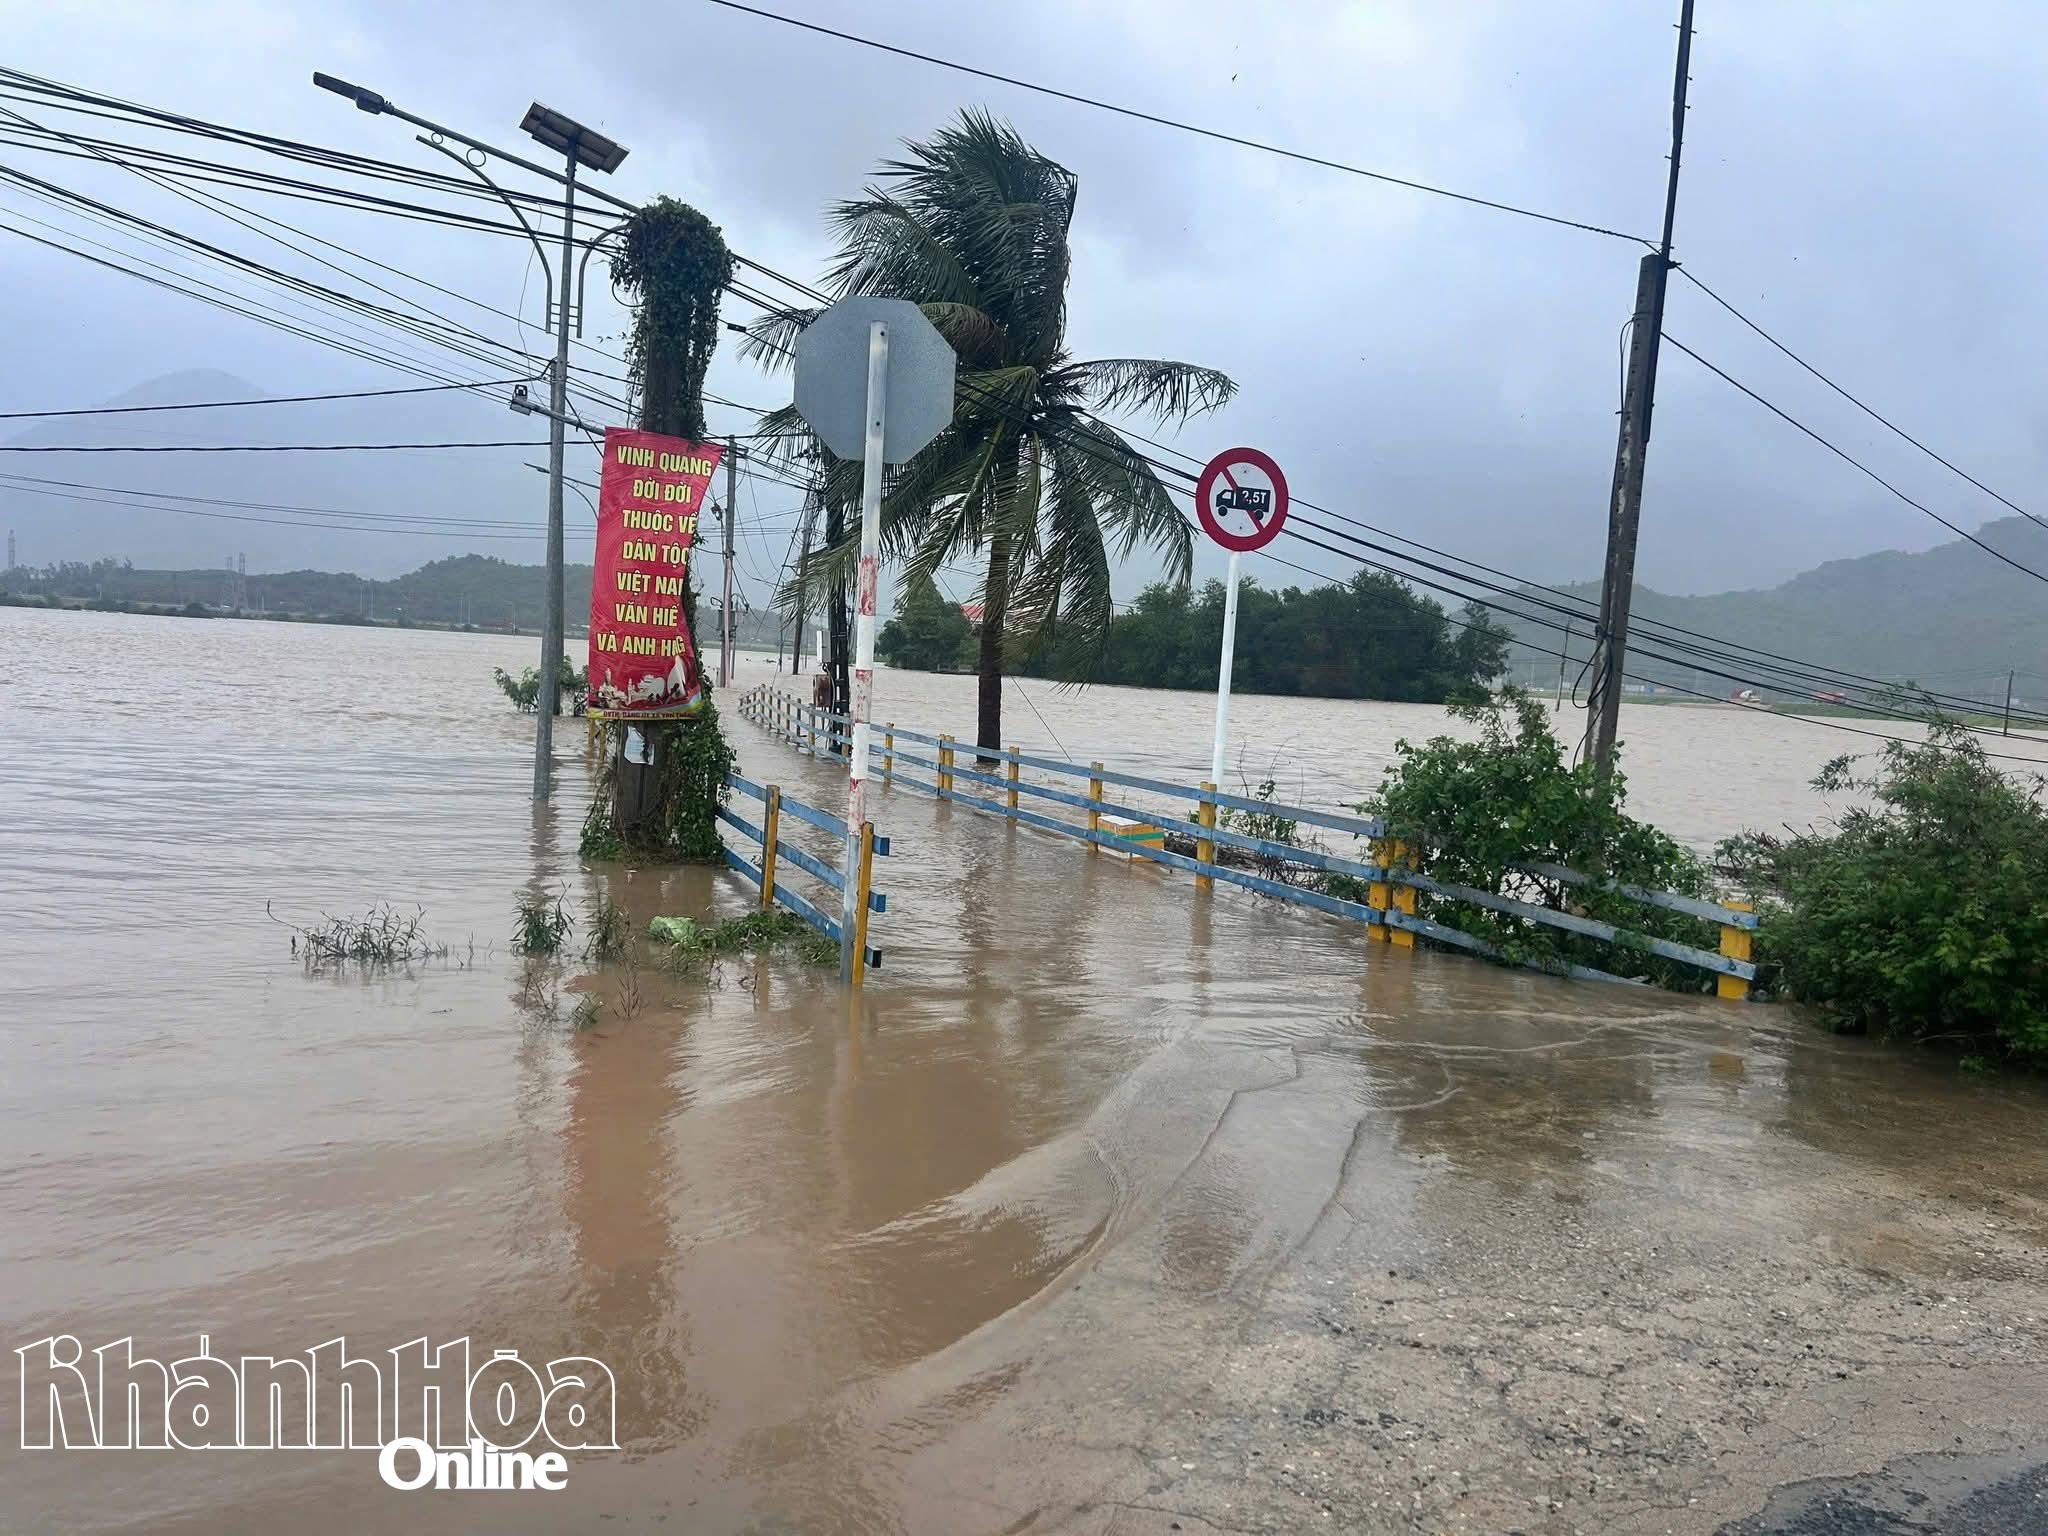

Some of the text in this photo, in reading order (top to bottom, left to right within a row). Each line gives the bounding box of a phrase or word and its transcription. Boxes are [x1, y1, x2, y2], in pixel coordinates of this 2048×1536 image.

[617, 445, 712, 477] VINH QUANG
[633, 477, 692, 504] ĐỜI ĐỜI
[622, 509, 673, 534] THUỘC
[622, 538, 657, 562] DÂN
[616, 569, 651, 596] VIỆT
[615, 601, 680, 627] VĂN HIẾ
[597, 630, 618, 652] VÀ
[622, 635, 656, 656] ANH
